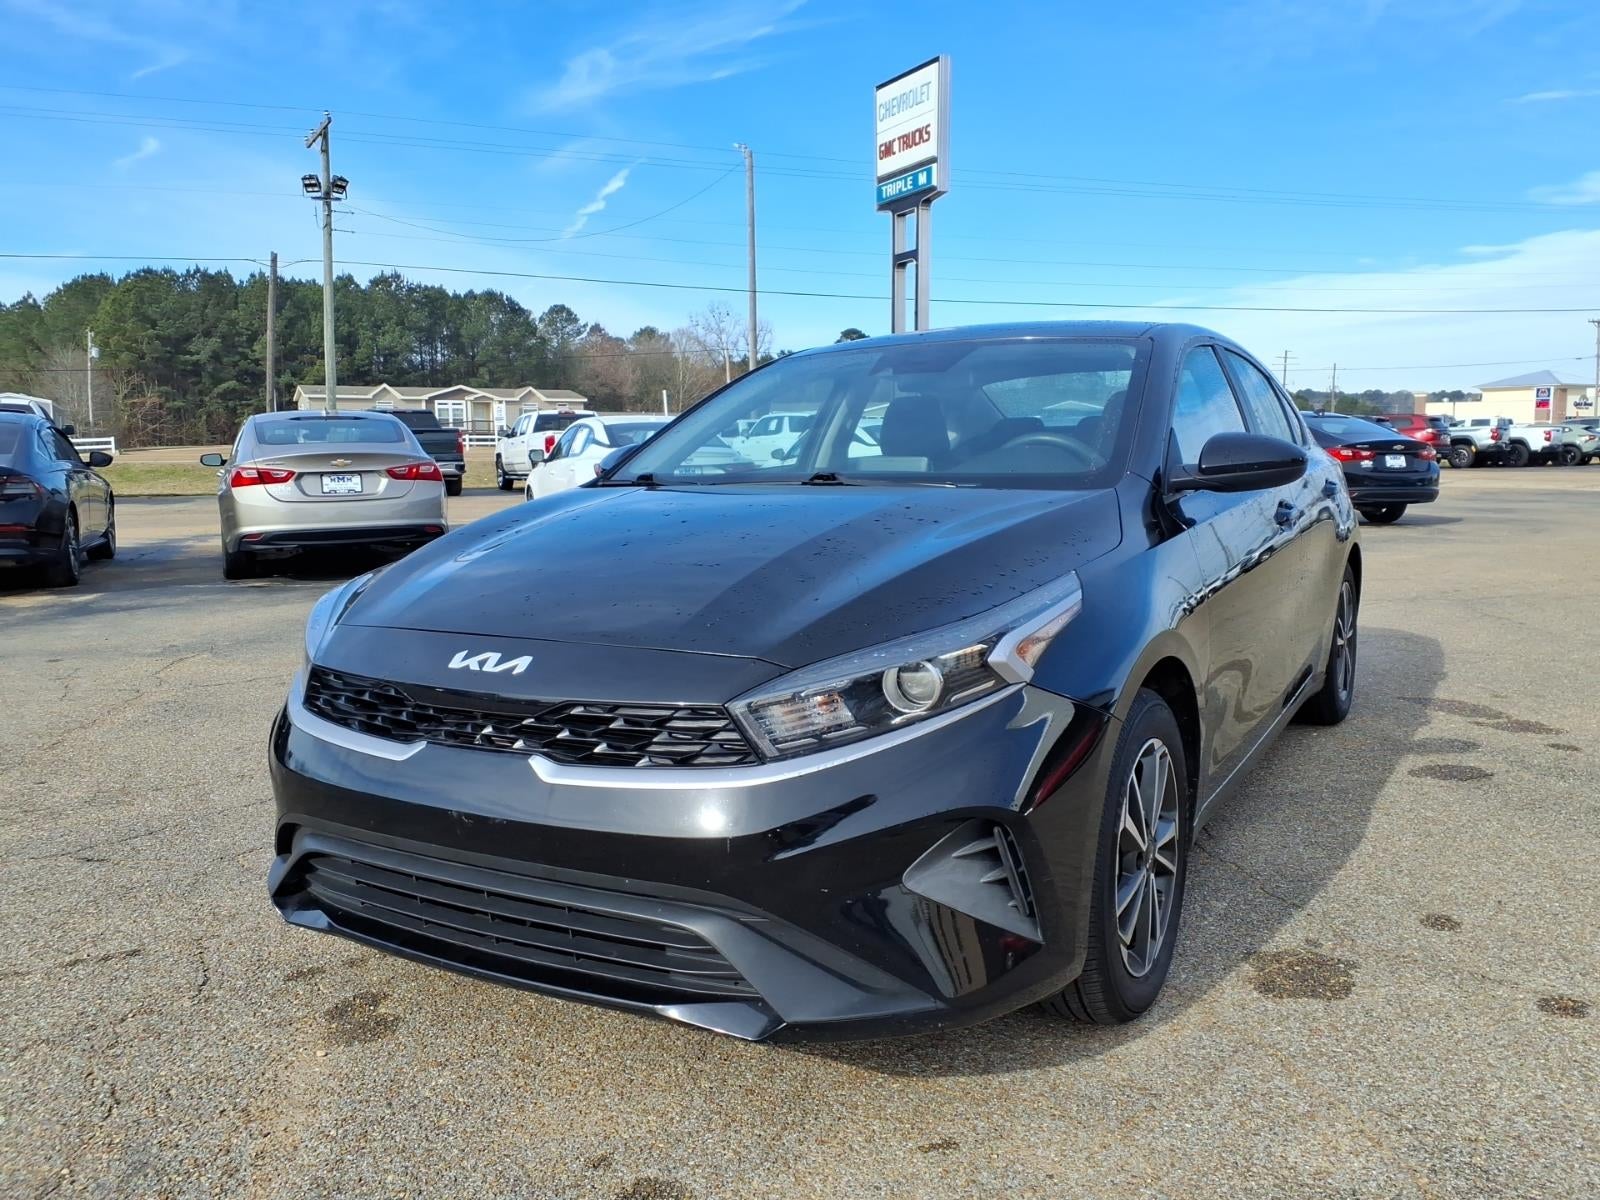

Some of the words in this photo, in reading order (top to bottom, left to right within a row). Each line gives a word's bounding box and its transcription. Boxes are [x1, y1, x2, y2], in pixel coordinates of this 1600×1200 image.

[878, 81, 932, 122] CHEVROLET
[879, 138, 897, 160] GMC
[897, 124, 931, 153] TRUCKS
[881, 176, 912, 198] TRIPLE
[918, 171, 927, 186] M
[448, 649, 534, 675] KIA
